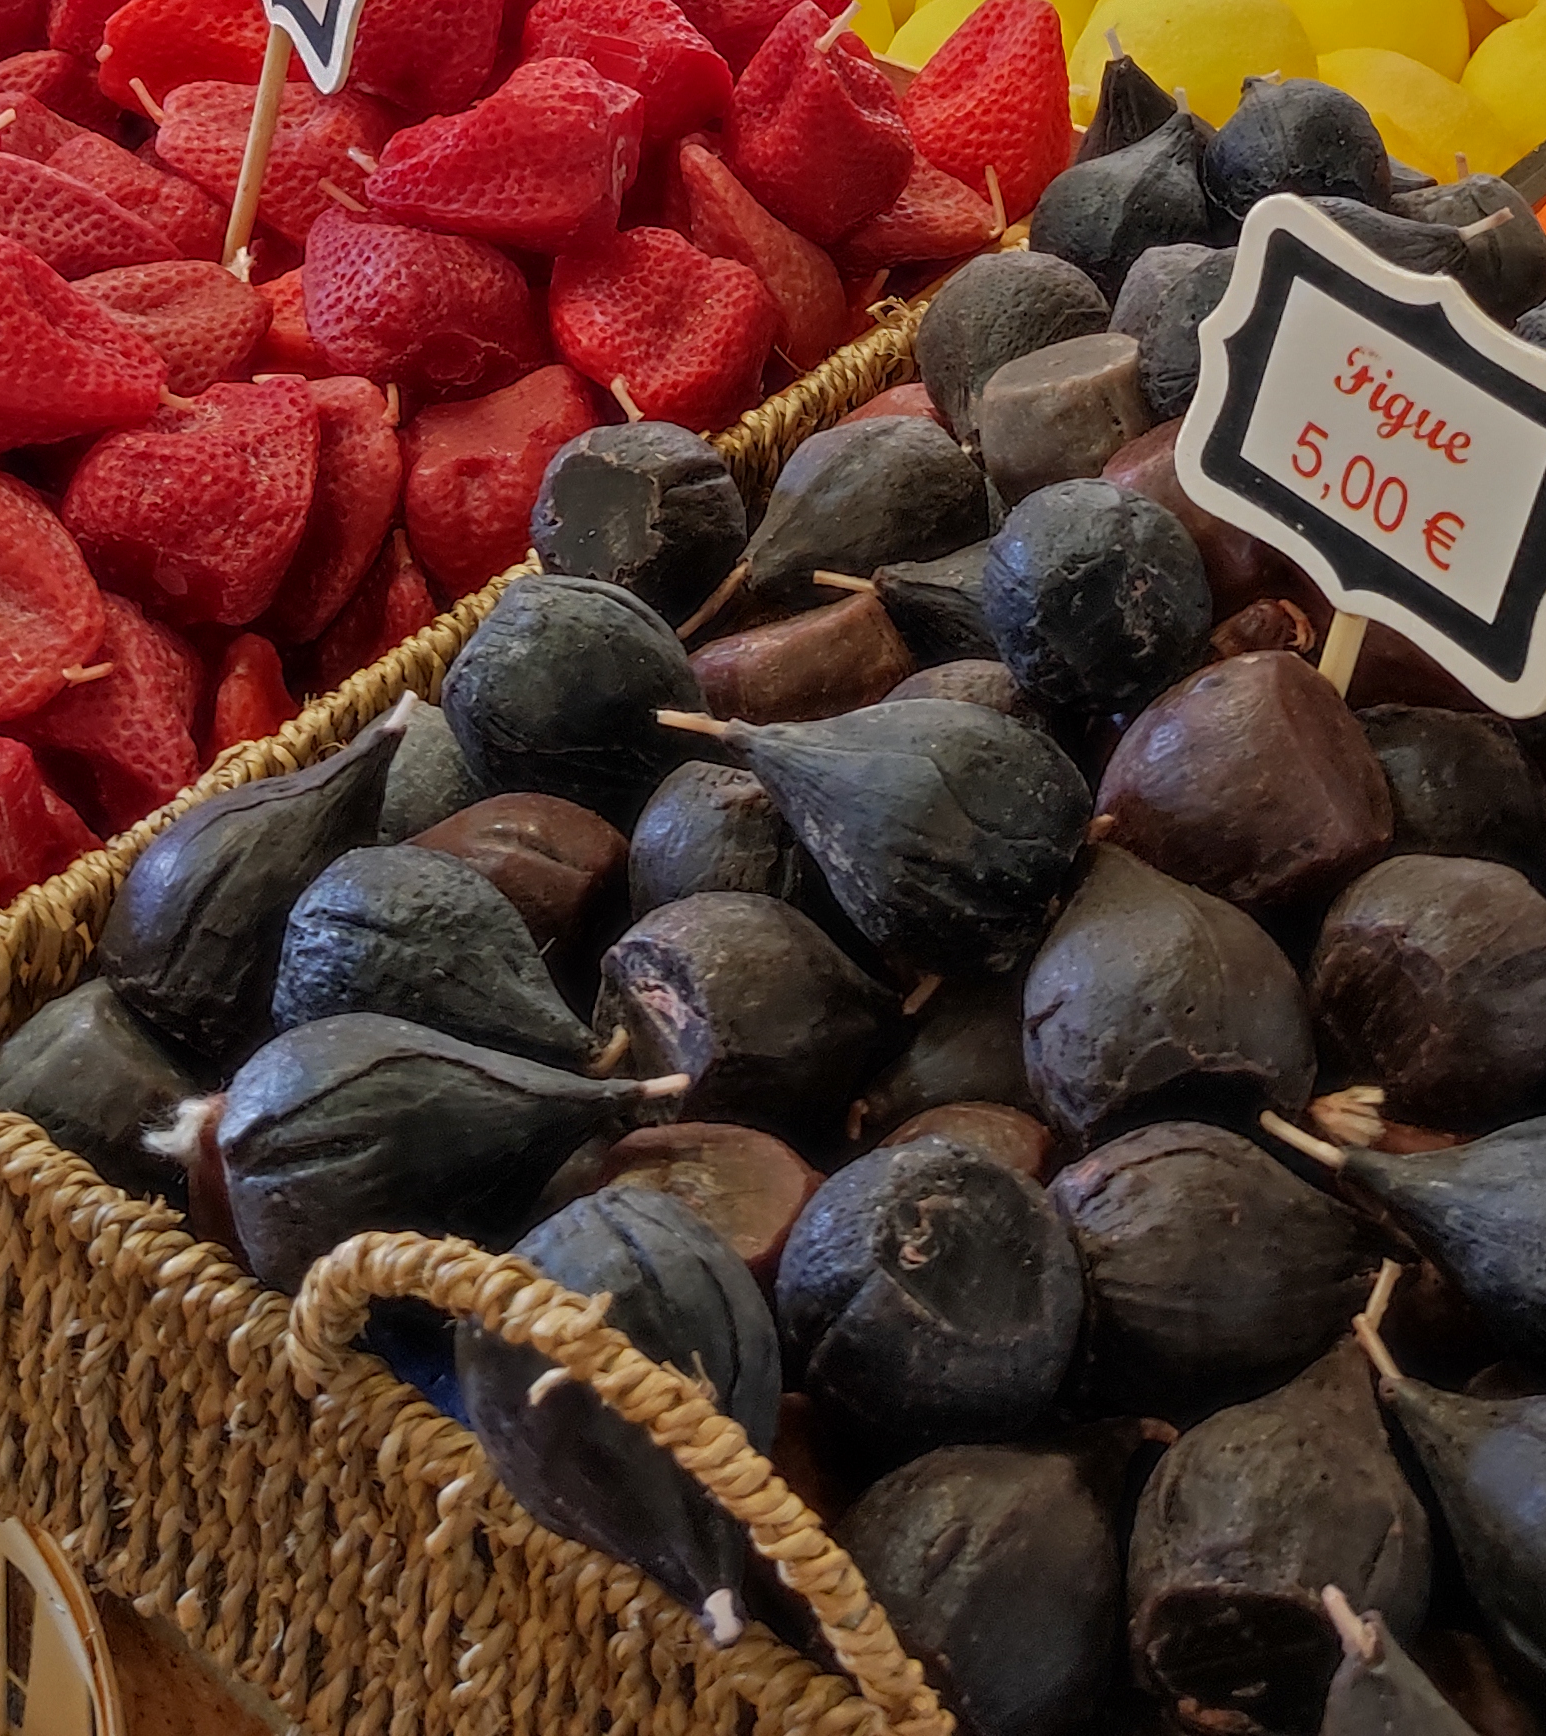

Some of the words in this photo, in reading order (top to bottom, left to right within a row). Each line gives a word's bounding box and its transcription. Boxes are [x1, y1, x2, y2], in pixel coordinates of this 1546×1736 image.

[1333, 345, 1473, 466] Figue
[1290, 420, 1409, 535] 5,00
[1421, 510, 1466, 572] €
